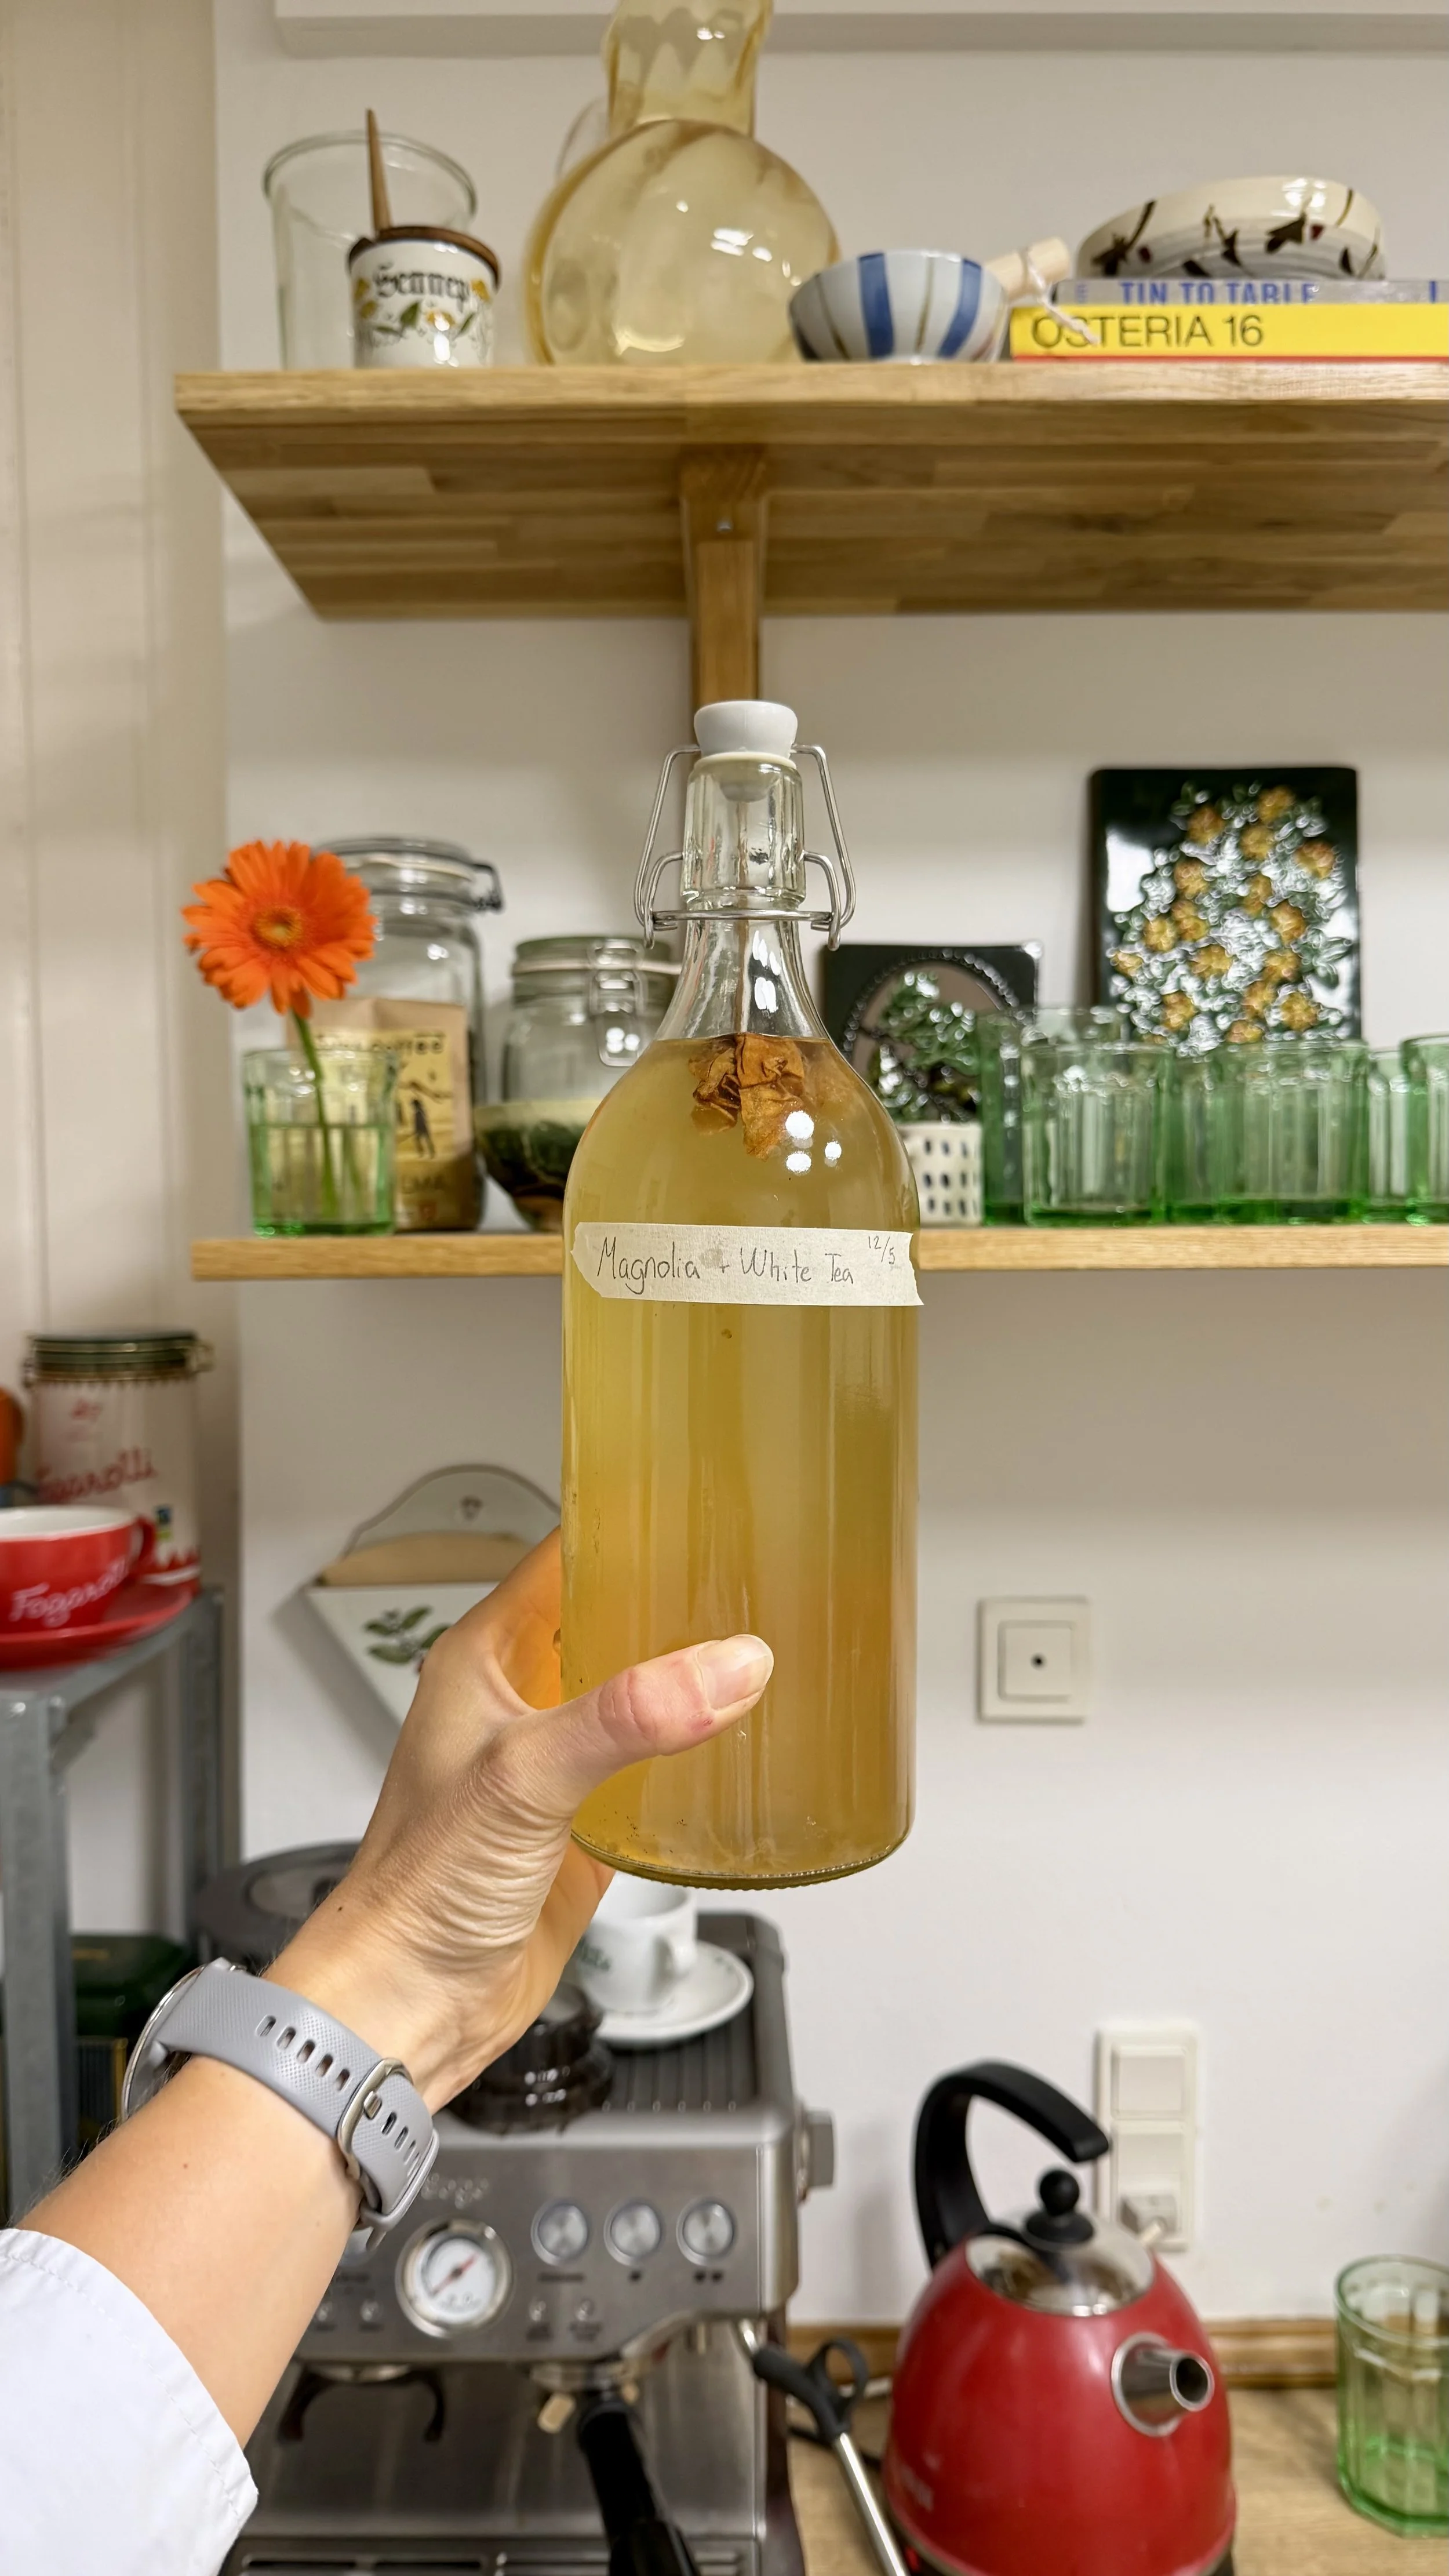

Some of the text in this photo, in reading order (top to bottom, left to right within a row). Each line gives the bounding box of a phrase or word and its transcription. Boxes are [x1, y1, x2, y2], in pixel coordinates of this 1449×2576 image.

[1119, 281, 1167, 304] TIN
[1180, 281, 1214, 304] TO
[1032, 314, 1262, 348] OSTERIA 16
[597, 1236, 854, 1295] Magnolia + White Tea
[868, 1235, 897, 1265] 12/5
